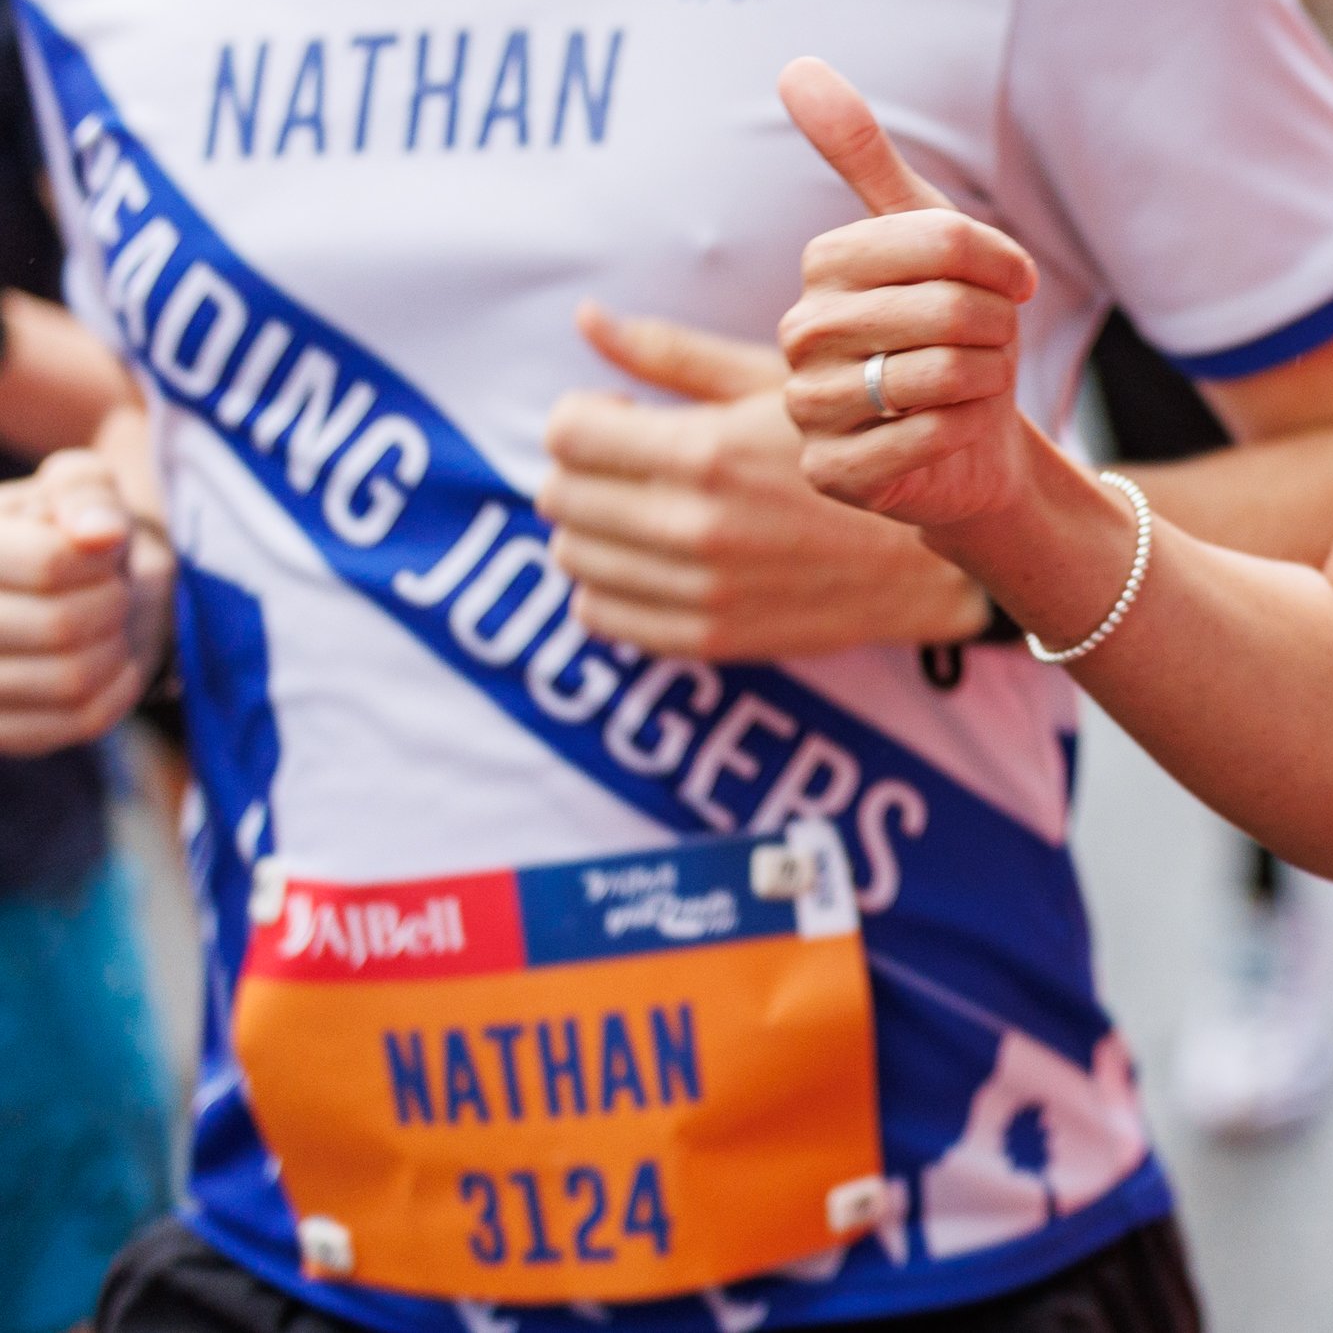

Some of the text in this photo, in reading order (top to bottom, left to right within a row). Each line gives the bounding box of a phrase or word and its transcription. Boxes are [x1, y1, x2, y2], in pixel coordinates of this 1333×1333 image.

[202, 28, 627, 162] NATHAN
[393, 502, 929, 914] JOGGERS
[382, 1001, 704, 1126] NATHAN
[458, 1158, 674, 1269] 3124
